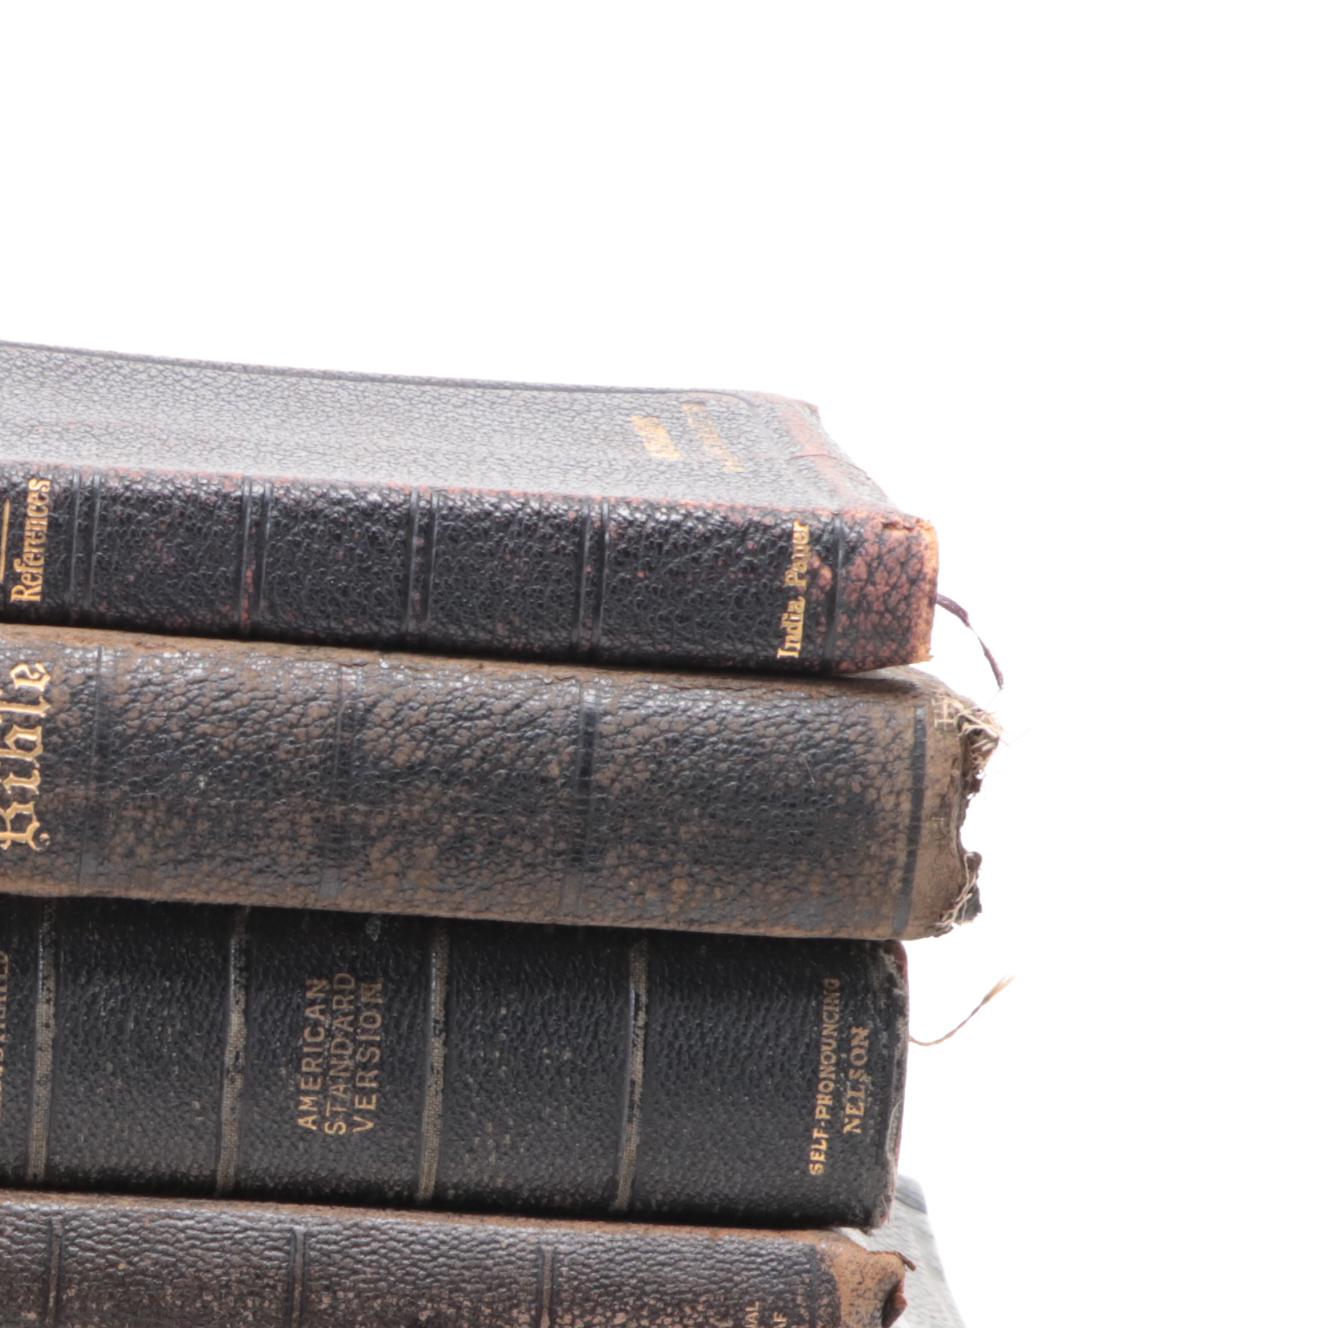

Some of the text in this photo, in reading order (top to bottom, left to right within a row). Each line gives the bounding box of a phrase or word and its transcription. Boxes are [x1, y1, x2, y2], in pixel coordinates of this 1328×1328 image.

[10, 478, 51, 603] References
[777, 596, 806, 659] India
[297, 977, 330, 1131] AMERICAN
[324, 972, 356, 1136] STANDARD
[351, 976, 385, 1134] VERSION
[843, 1025, 871, 1135] NELSON
